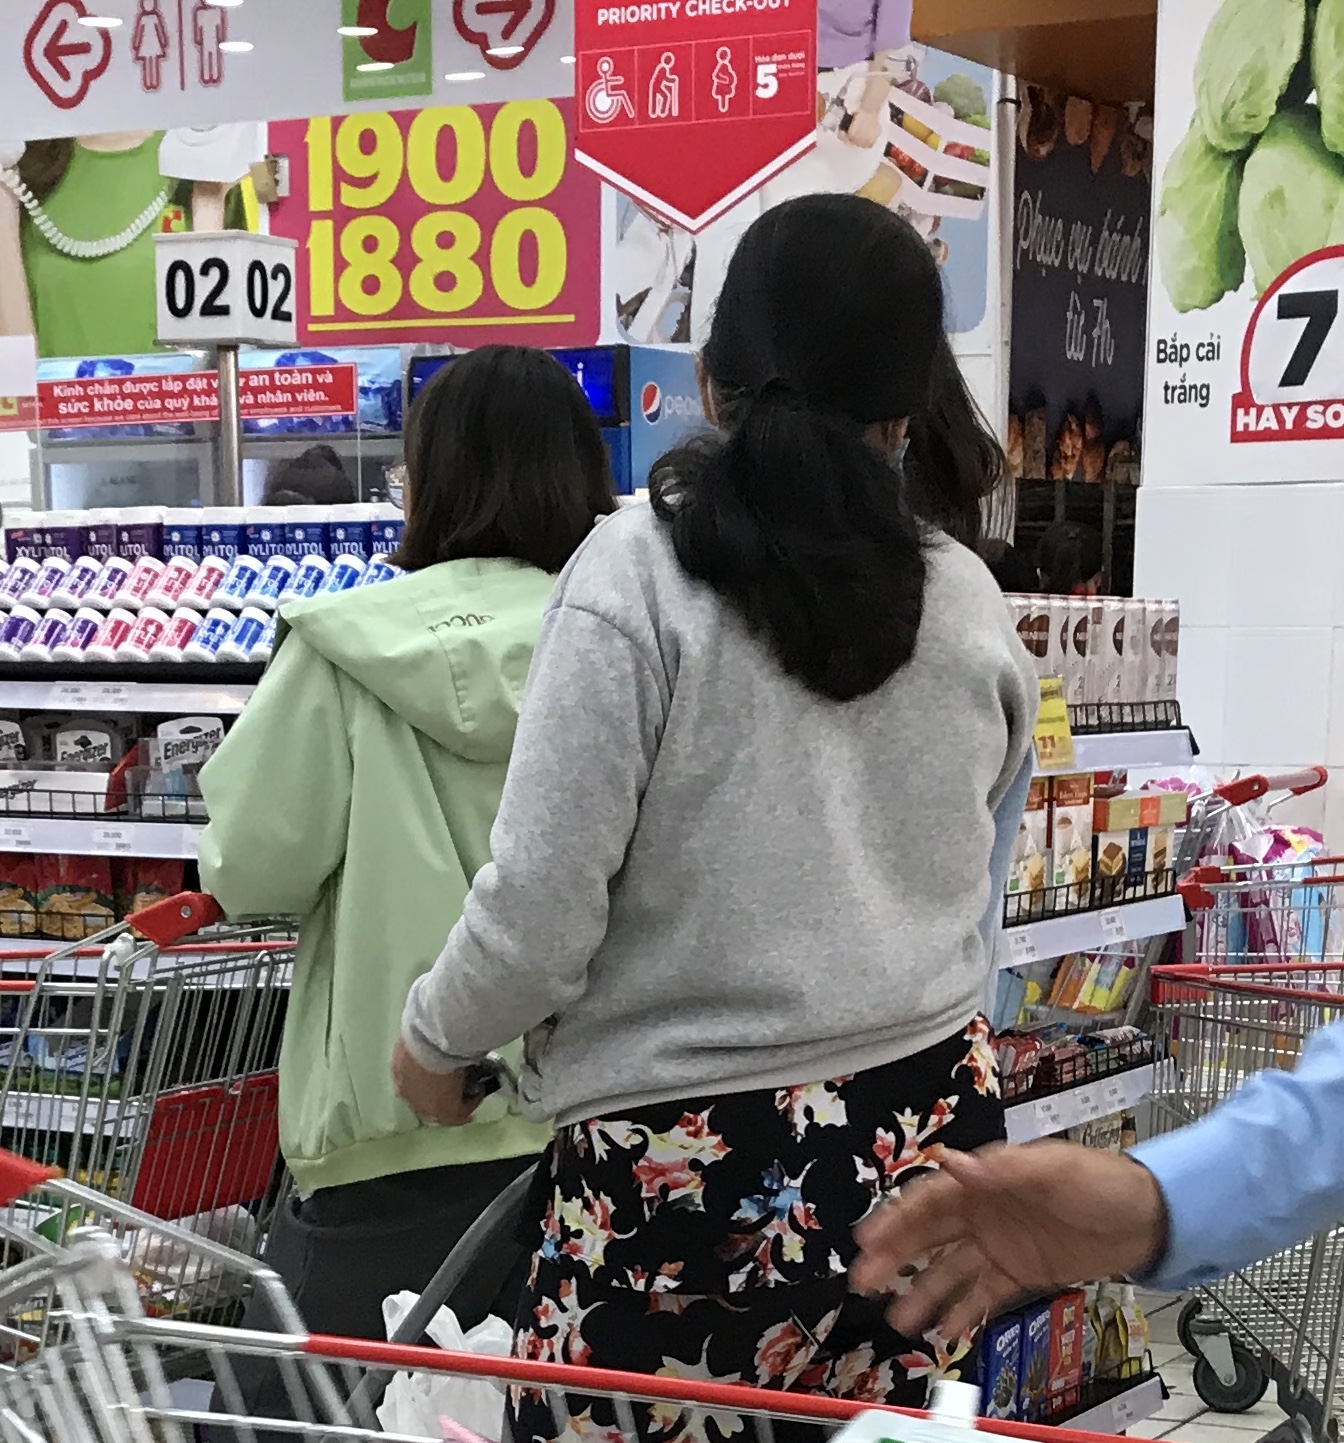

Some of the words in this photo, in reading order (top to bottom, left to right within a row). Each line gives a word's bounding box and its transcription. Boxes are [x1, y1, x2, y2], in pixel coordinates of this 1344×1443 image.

[597, 2, 680, 26] PRIORITY
[755, 63, 778, 98] 5
[308, 98, 567, 212] 1900
[308, 206, 567, 316] 1880
[165, 257, 230, 318] 02
[246, 260, 293, 324] 02
[1157, 332, 1190, 366] Bắp
[1195, 331, 1221, 361] cải
[1276, 289, 1339, 388] 7
[273, 369, 313, 385] toàn
[316, 369, 333, 384] và
[1163, 373, 1210, 408] trắng
[192, 390, 219, 407] khá
[248, 543, 285, 557] XYLITO
[996, 1323, 1022, 1352] OREO
[1028, 1309, 1052, 1338] OREO
